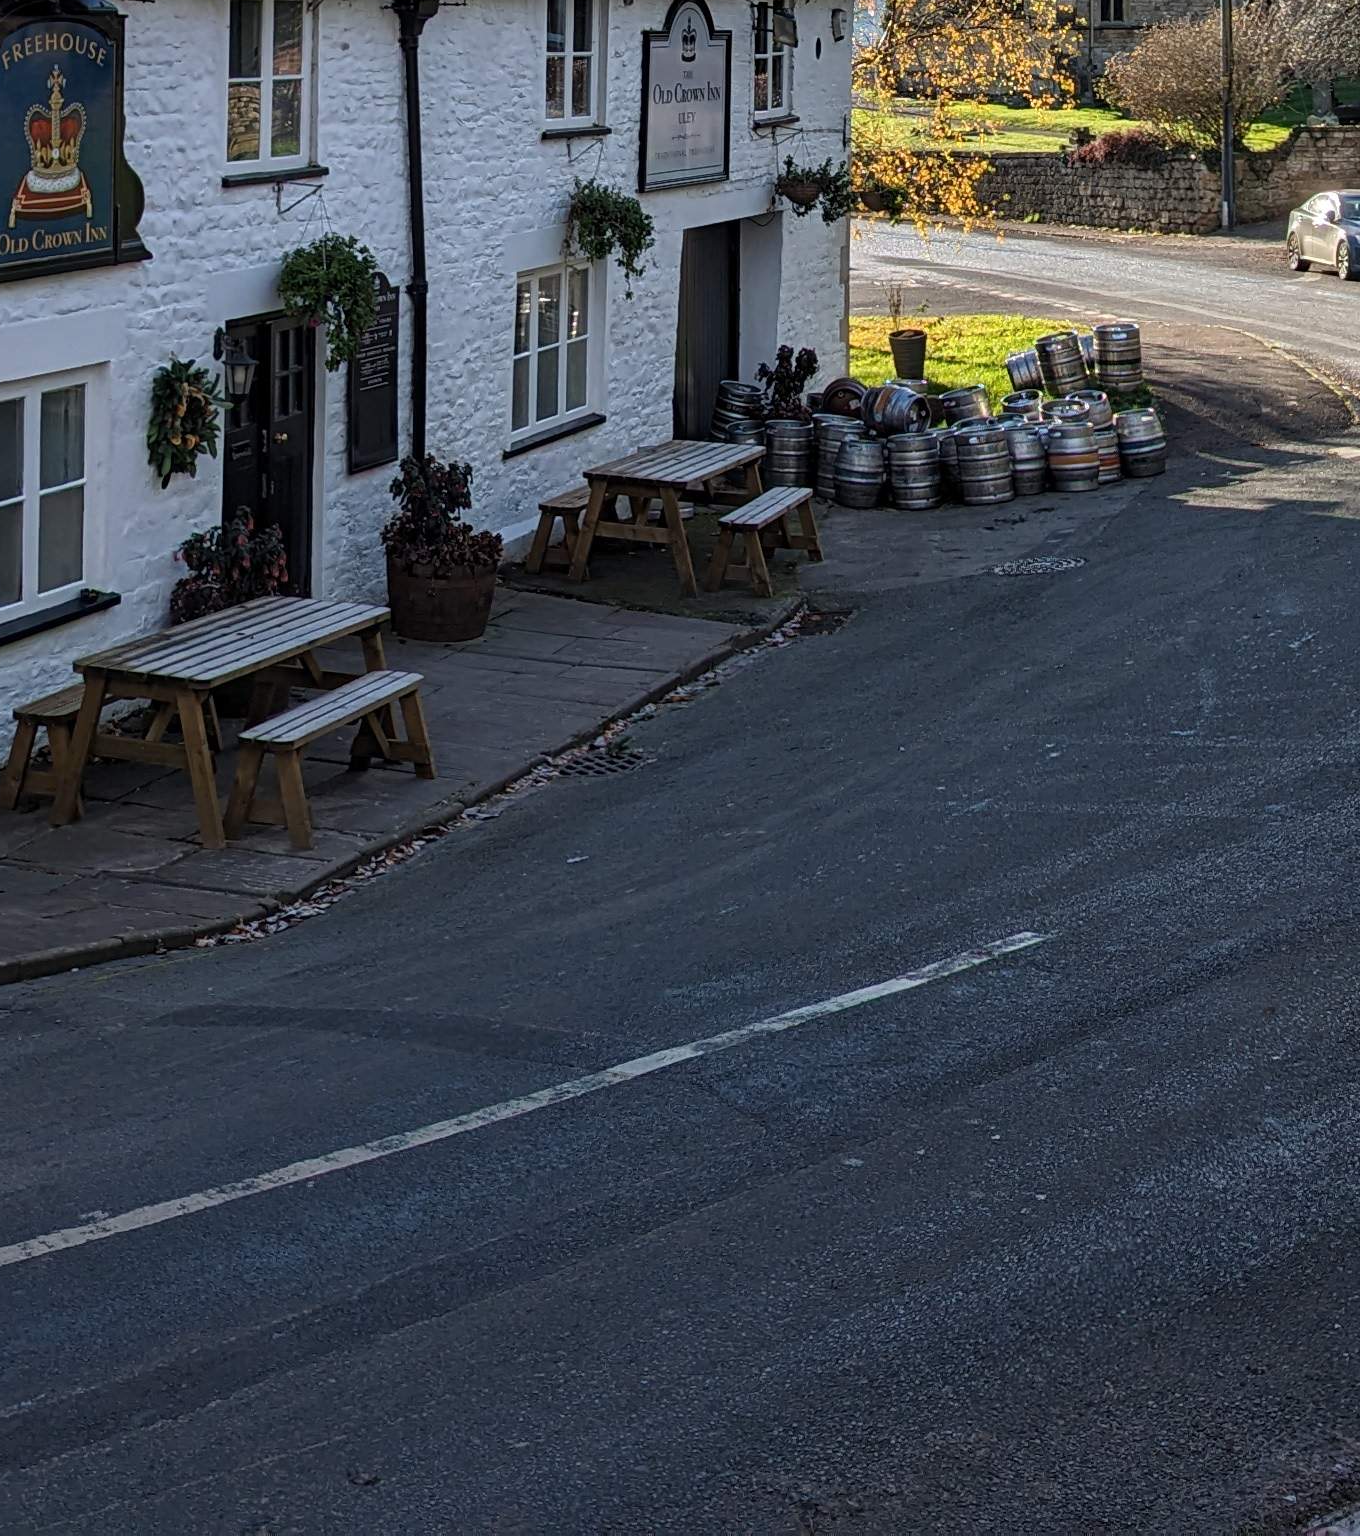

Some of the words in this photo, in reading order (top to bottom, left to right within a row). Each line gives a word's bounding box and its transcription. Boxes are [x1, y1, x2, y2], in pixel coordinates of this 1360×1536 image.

[1, 32, 107, 70] FREEHOUSE
[653, 83, 673, 105] OLD
[674, 82, 705, 104] CROWN
[707, 80, 721, 102] INN
[678, 111, 696, 125] ULEY
[32, 229, 82, 251] CROWN
[85, 222, 107, 243] INN
